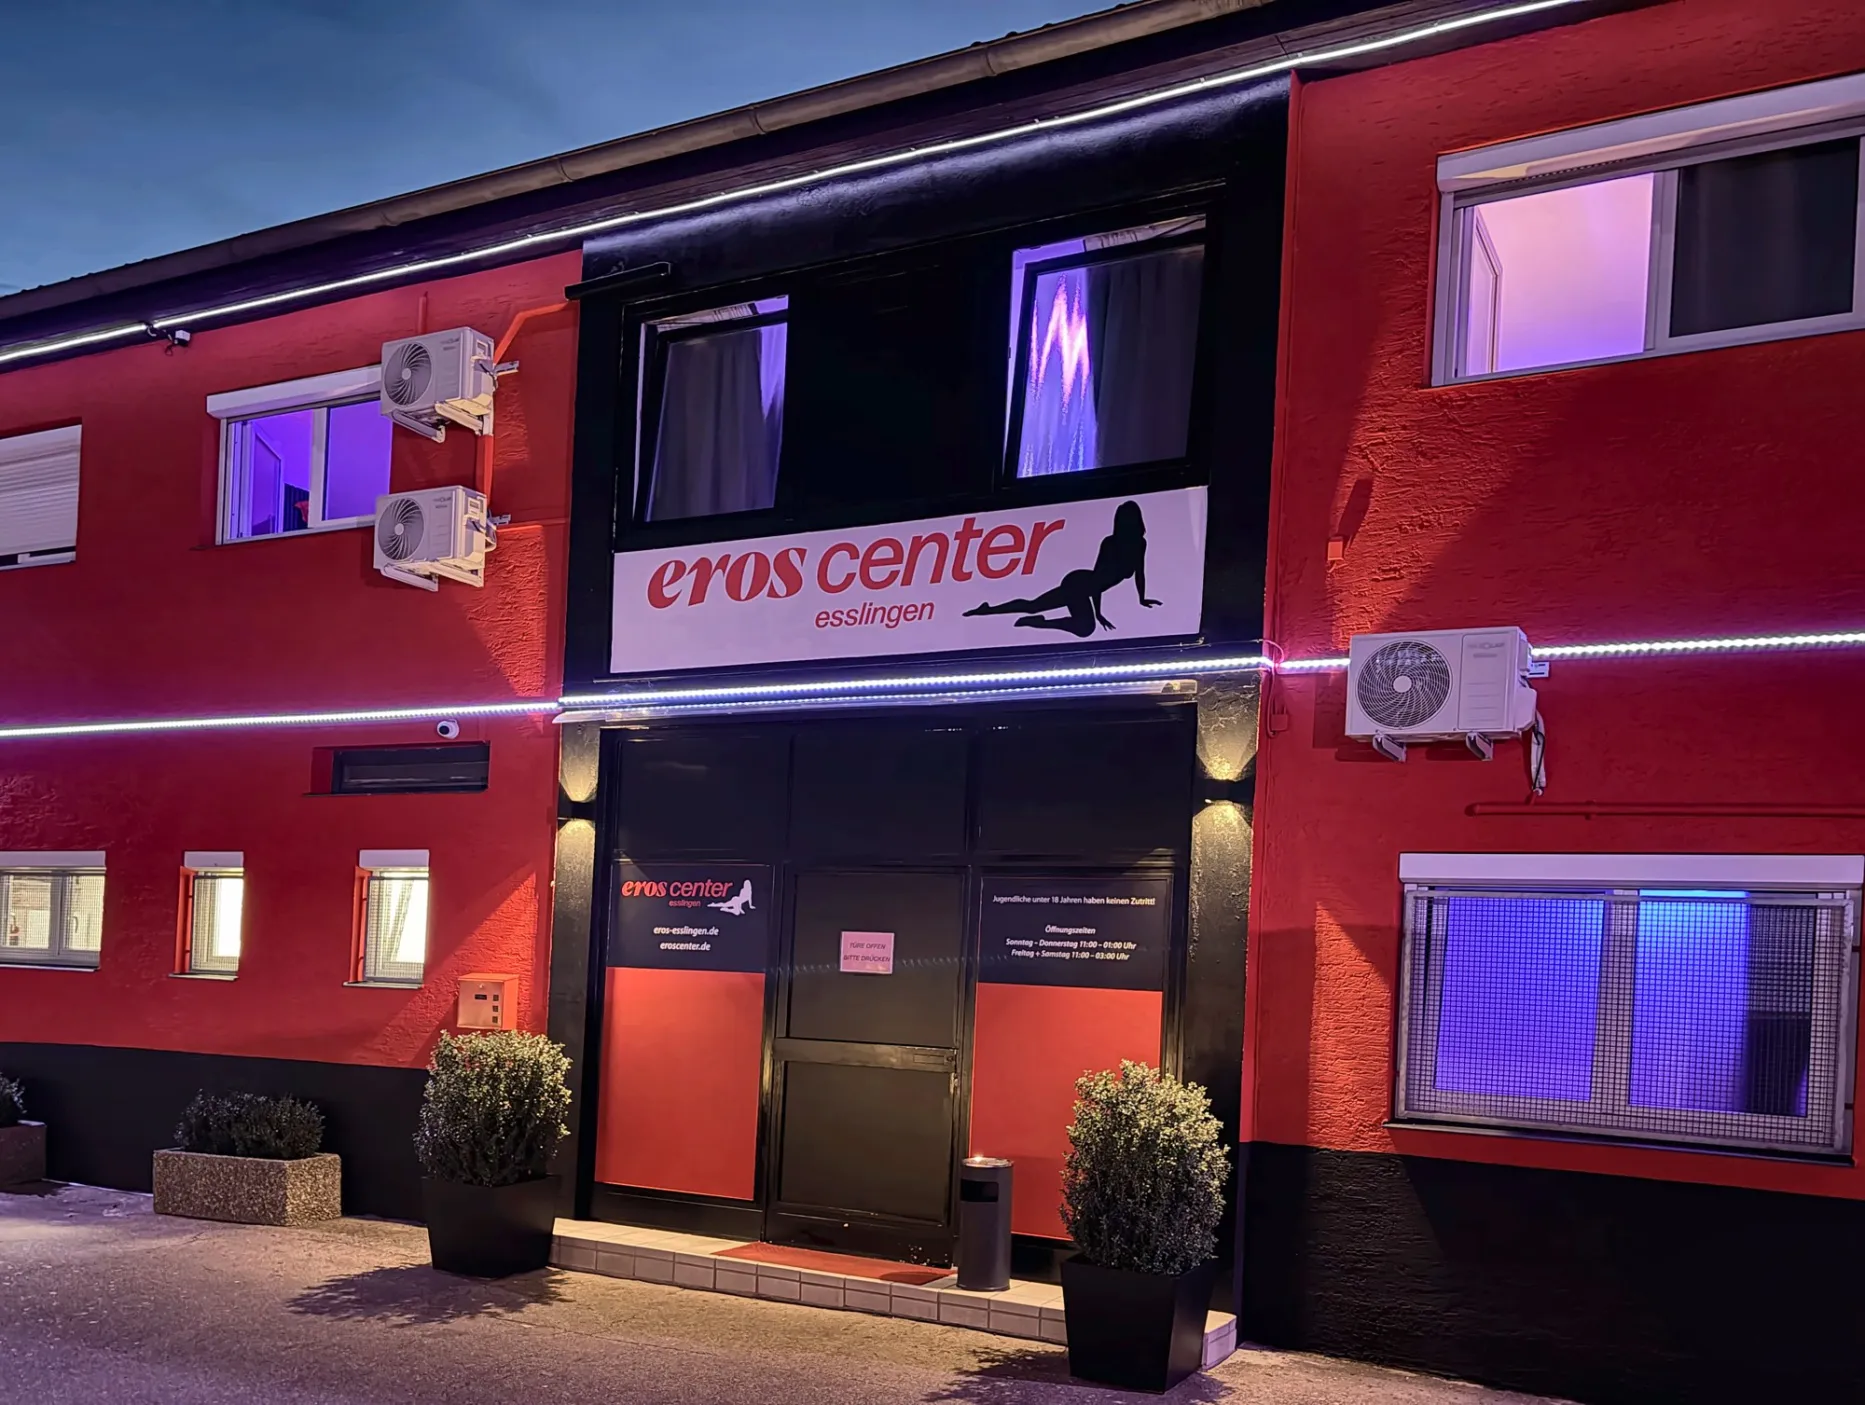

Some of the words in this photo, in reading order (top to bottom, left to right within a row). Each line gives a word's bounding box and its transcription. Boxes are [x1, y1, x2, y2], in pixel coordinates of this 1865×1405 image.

[646, 545, 808, 609] eros
[816, 517, 1065, 594] center
[814, 600, 936, 629] esslingen
[621, 880, 668, 897] eros
[669, 878, 734, 897] center
[668, 899, 702, 908] esslingen
[992, 895, 1032, 904] Jugendliche
[1060, 896, 1083, 904] Jahren
[1083, 896, 1105, 904] haben
[1106, 896, 1130, 905] keinen
[1130, 897, 1156, 906] Zutritt!
[653, 925, 720, 937] eros-esslingen.de
[1045, 924, 1097, 935] Öffnungszeiten
[659, 941, 711, 951] eroscenter.de
[865, 942, 887, 950] OFFEN
[1005, 938, 1034, 948] Sonntag
[1039, 939, 1079, 949] Donnerstag
[1080, 940, 1098, 949] 11:00
[1103, 941, 1123, 949] 01:00
[1123, 942, 1138, 950] Uhr
[1011, 949, 1035, 959] Freitag
[1041, 950, 1071, 960] Samstag
[1071, 951, 1090, 959] 11:00
[1095, 951, 1116, 960] 03:00
[1116, 952, 1131, 960] Uhr
